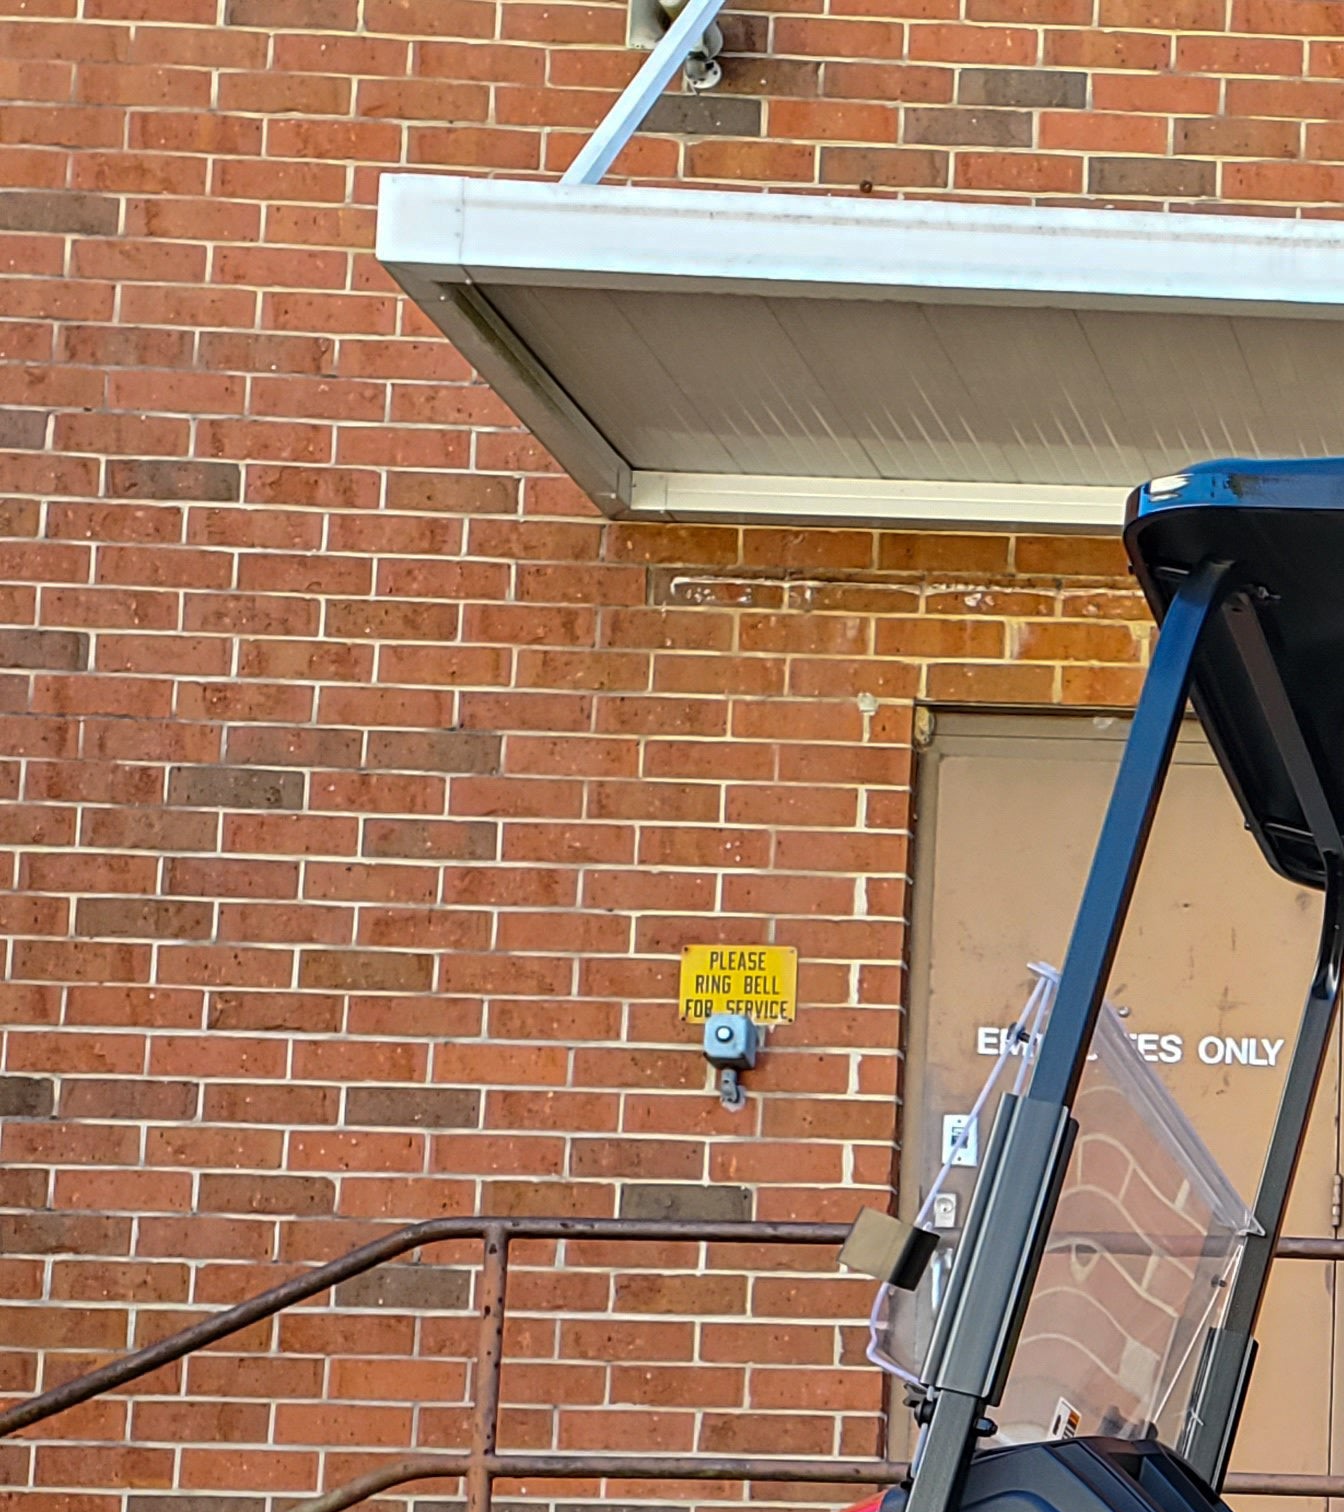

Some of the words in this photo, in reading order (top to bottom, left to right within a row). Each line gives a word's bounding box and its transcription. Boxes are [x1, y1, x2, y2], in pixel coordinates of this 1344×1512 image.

[710, 951, 767, 971] PLEASE
[695, 974, 732, 994] RING
[743, 975, 780, 995] BELL
[684, 999, 714, 1018] FOR
[726, 1000, 789, 1019] SERVICE
[1198, 1036, 1284, 1066] ONLY
